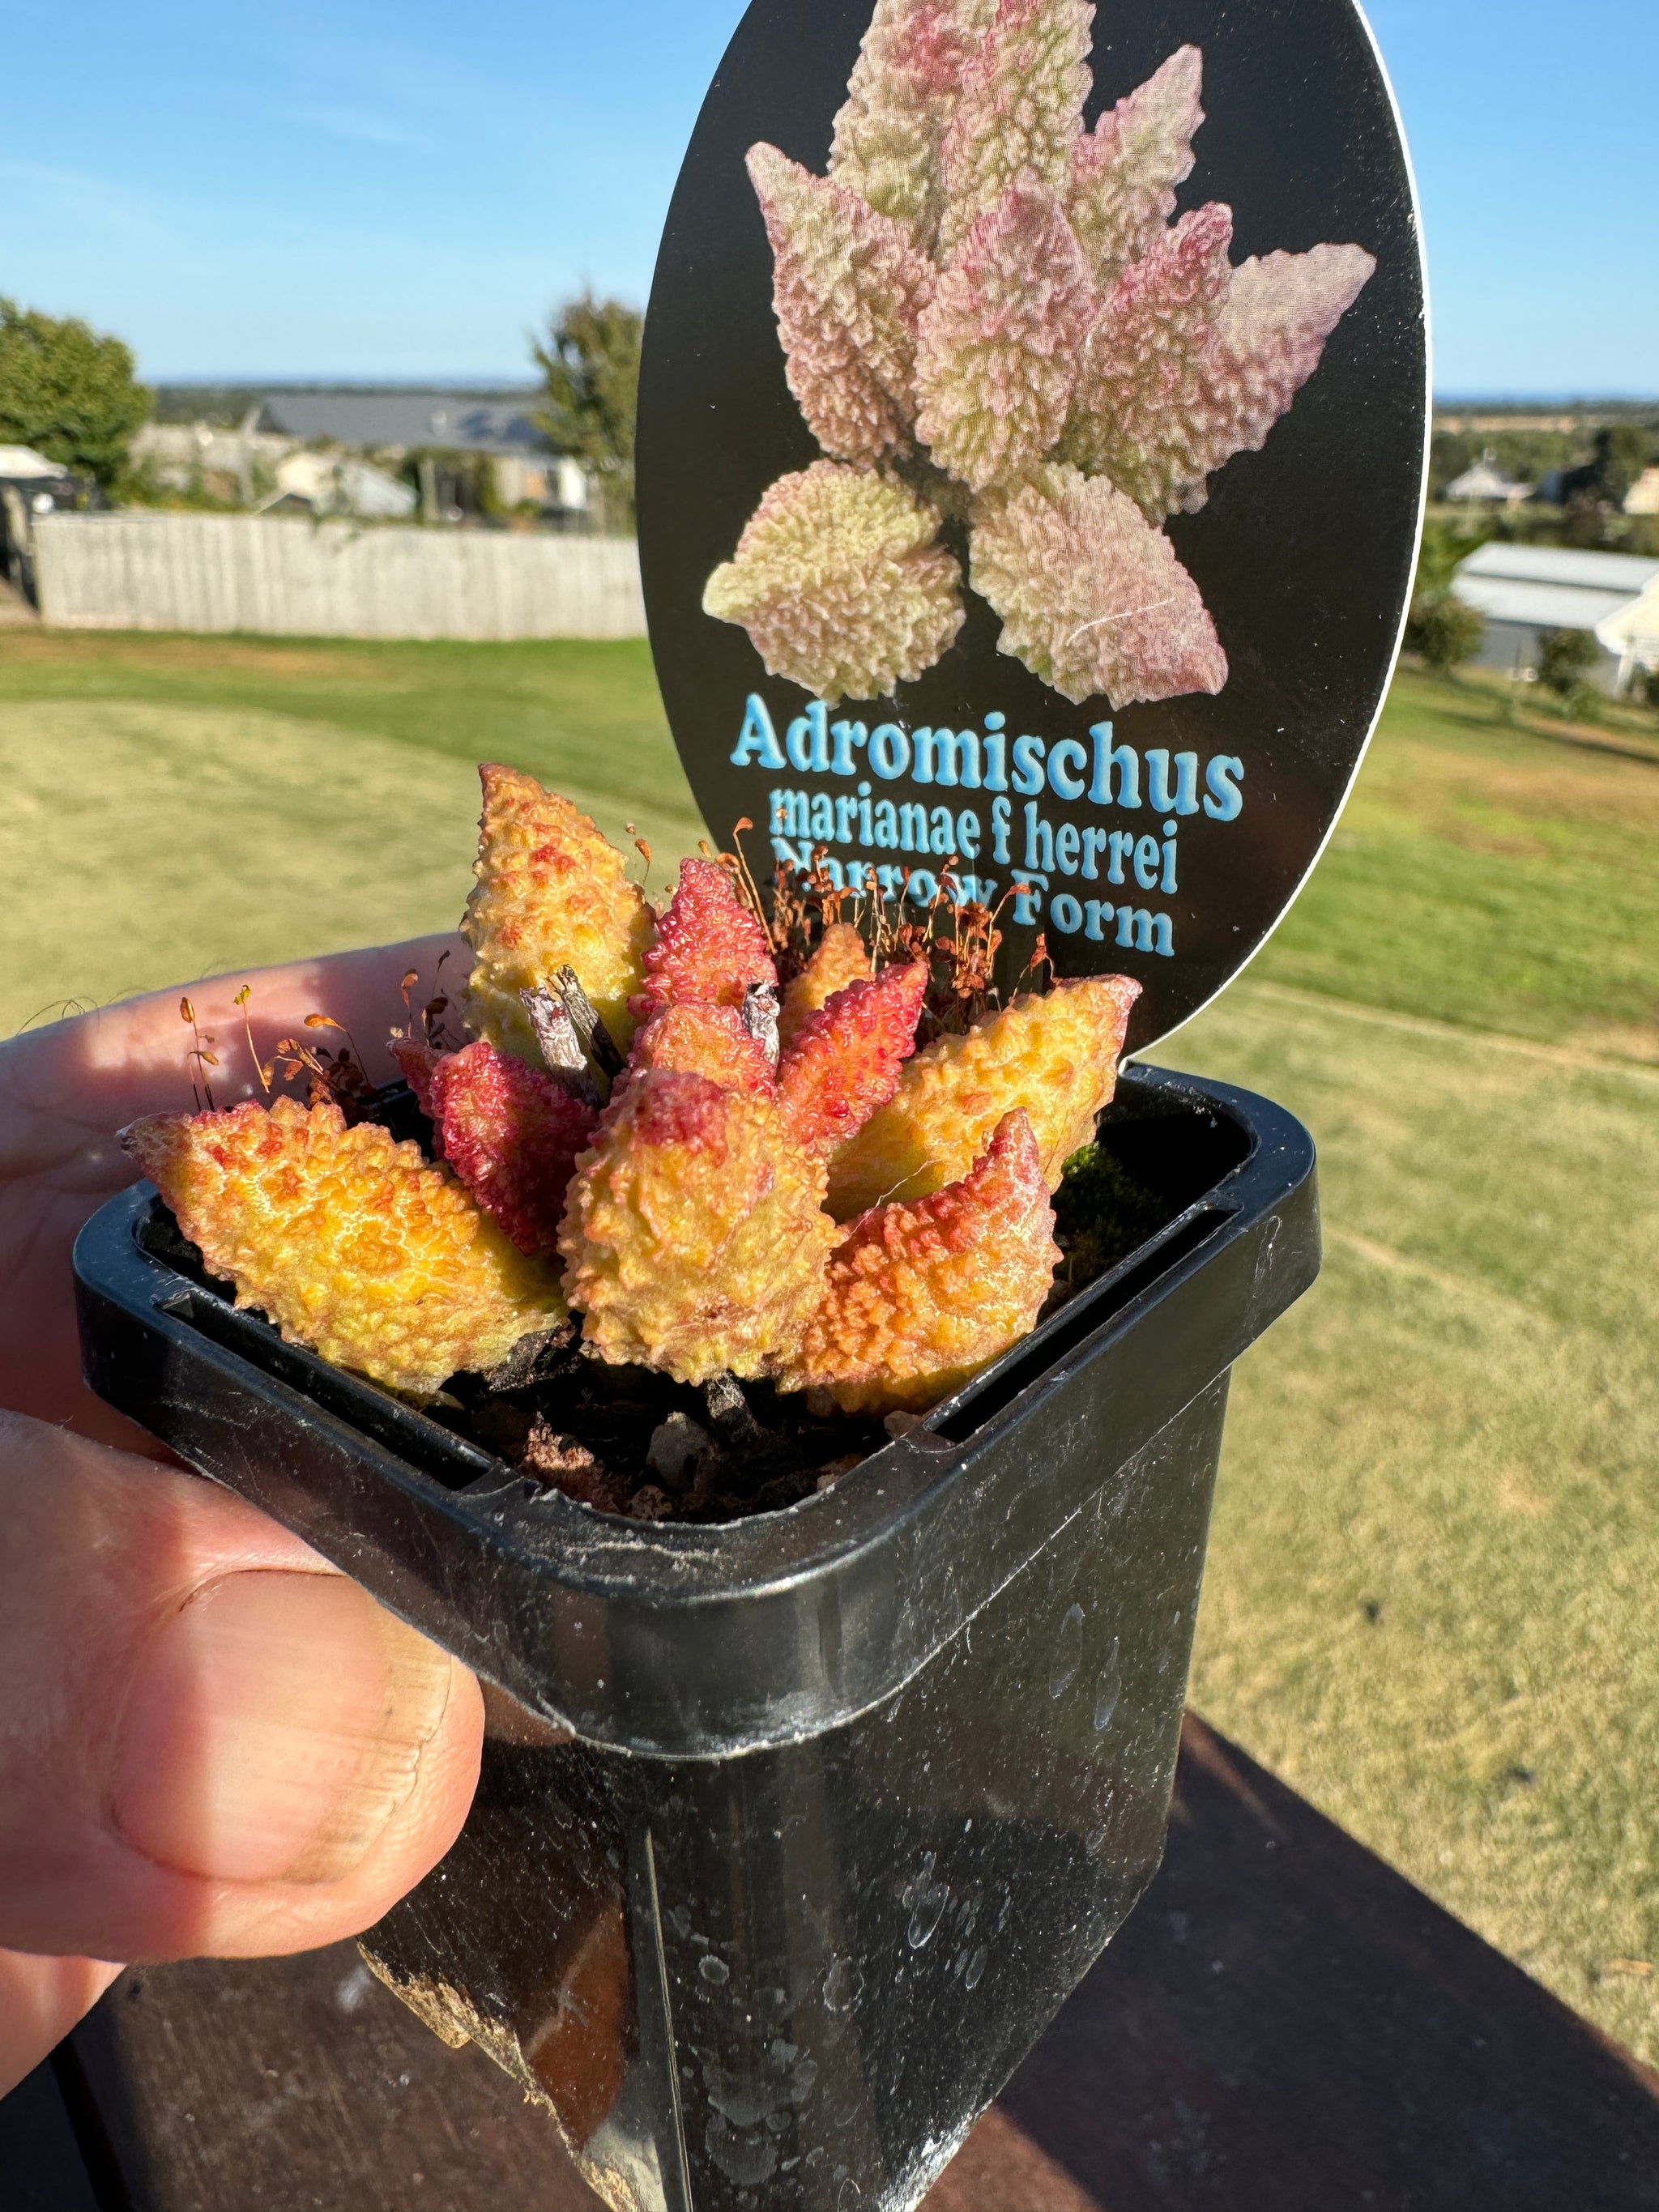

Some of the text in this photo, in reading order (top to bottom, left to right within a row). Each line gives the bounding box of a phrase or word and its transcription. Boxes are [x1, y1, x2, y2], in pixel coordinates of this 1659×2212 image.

[730, 693, 1244, 821] Adromischus
[769, 782, 1178, 894] marianae f herrei
[1011, 869, 1175, 957] Form
